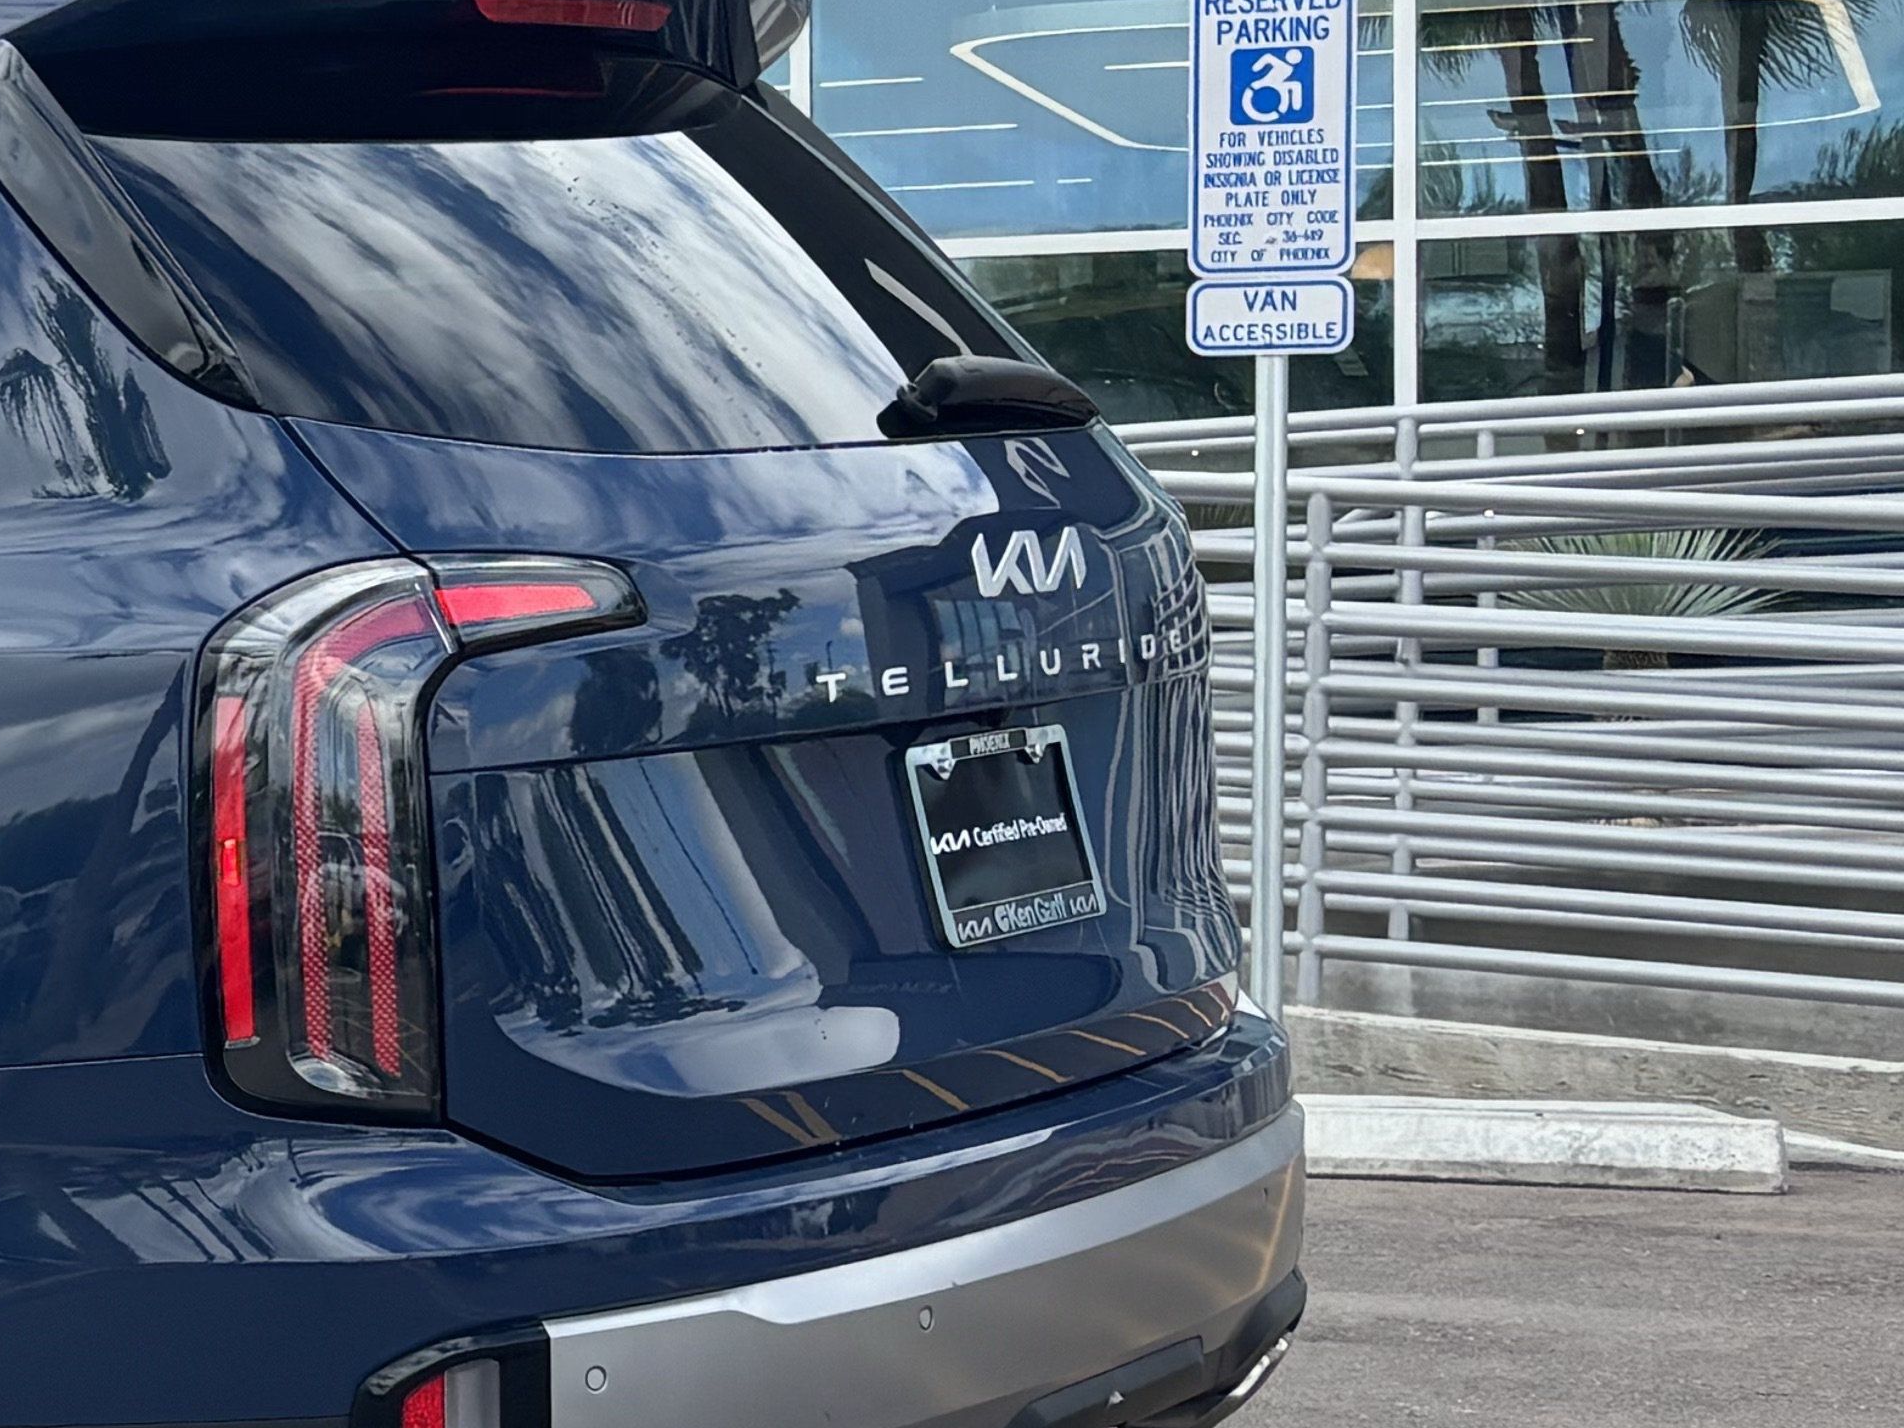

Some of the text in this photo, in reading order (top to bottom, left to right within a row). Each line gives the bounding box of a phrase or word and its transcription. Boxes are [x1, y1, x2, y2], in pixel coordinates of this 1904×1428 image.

[1216, 15, 1331, 46] PARKING
[1219, 128, 1325, 149] FOR VEHICLES
[1205, 148, 1339, 169] SHOWING DISABLED
[1203, 168, 1341, 189] INSIGNIA OR LICENSE
[1225, 189, 1318, 208] PLATE ONLY
[1203, 210, 1339, 228] PHOENIX CITY CODE
[1211, 247, 1330, 263] CITY OF PHOENIX
[1243, 289, 1297, 312] VAN
[1203, 321, 1338, 342] ACCESSIBLE
[971, 526, 1087, 598] KIA
[815, 627, 1184, 703] TELLURIDE
[972, 819, 1021, 847] Certified
